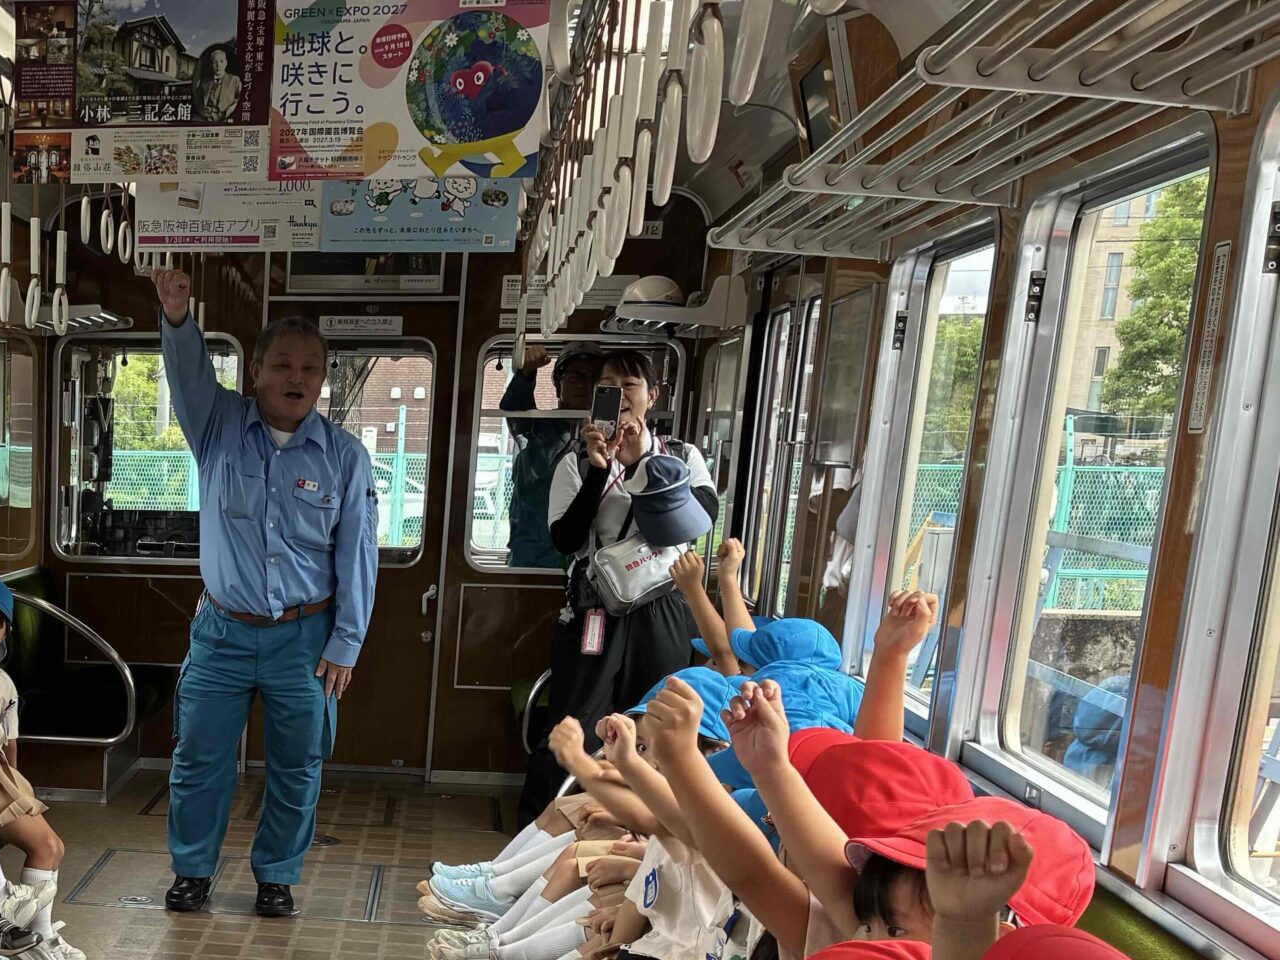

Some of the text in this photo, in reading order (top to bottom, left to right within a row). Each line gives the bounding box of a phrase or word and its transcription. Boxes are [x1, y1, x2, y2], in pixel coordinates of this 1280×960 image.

[373, 5, 407, 16] 2027
[282, 31, 368, 58] 地球と。
[382, 51, 403, 60] スタート
[281, 61, 354, 88] 咲きに
[79, 103, 192, 123] 小林一三記念館
[279, 92, 365, 117] 行こう。
[280, 126, 364, 137] 2027年国際園芸博覧会
[138, 219, 261, 233] 阪急阪神百貨店アプリ
[287, 214, 319, 231] Hankyu
